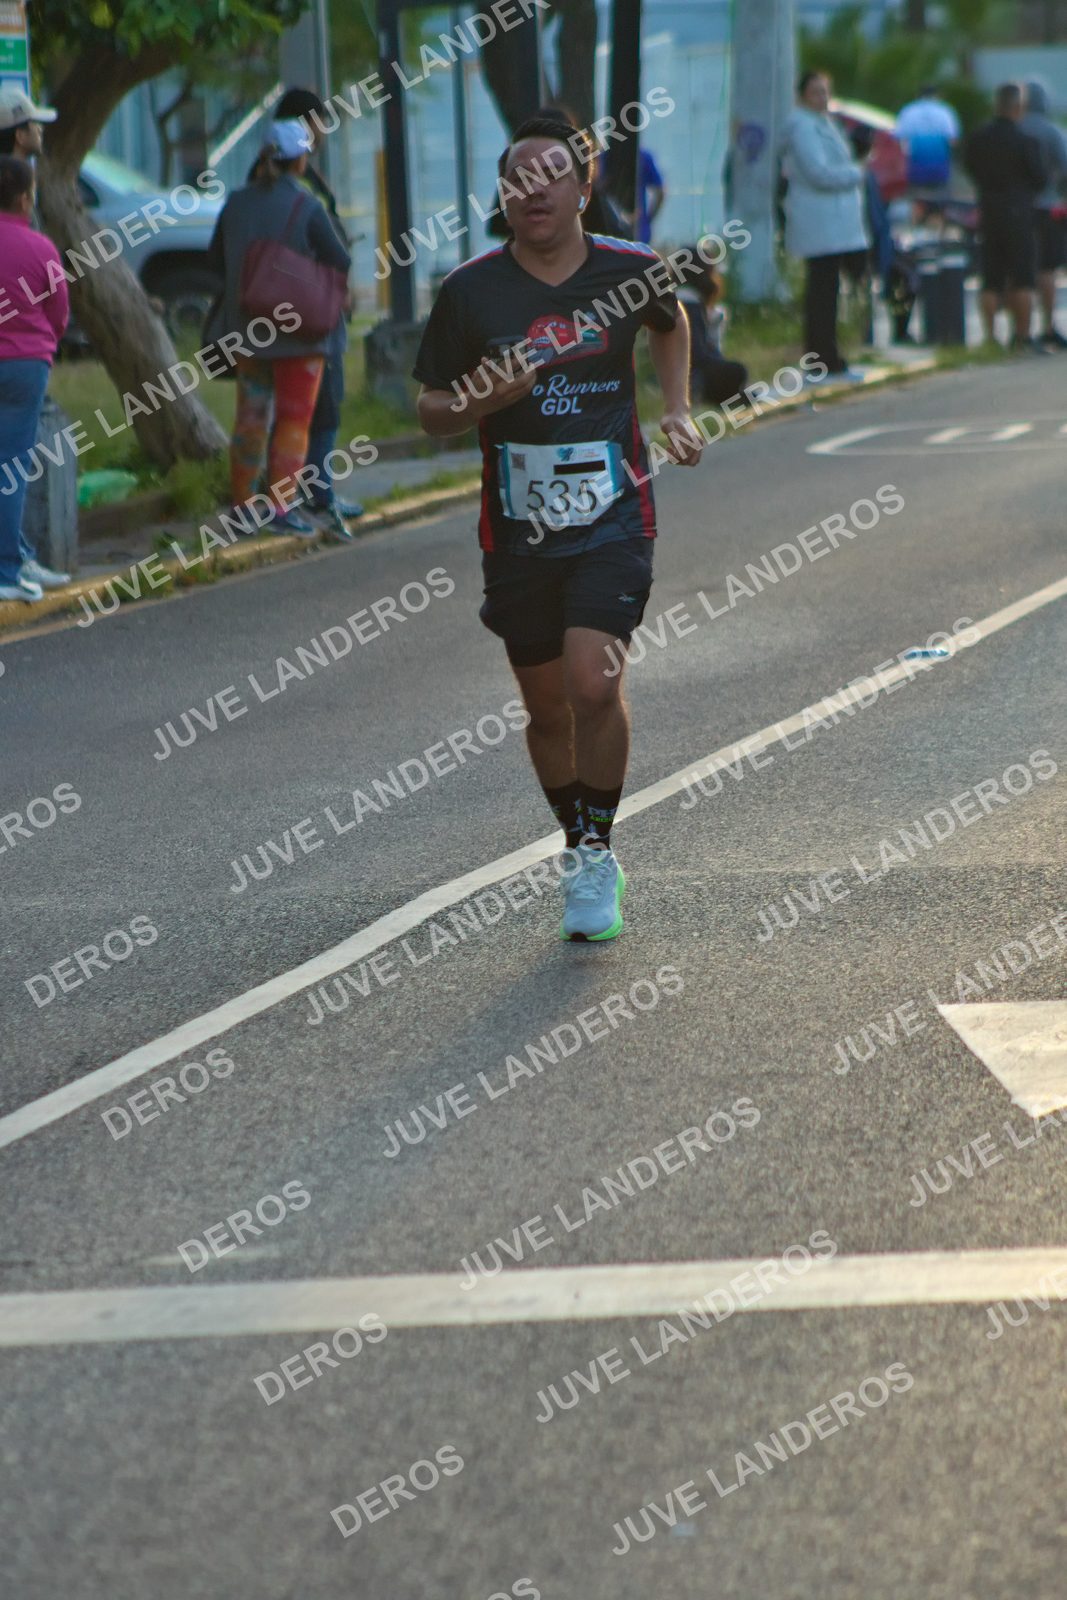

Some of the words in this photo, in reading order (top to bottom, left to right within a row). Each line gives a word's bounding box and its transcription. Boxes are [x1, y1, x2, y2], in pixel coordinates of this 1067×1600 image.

[546, 374, 621, 398] Runners
[540, 396, 583, 416] GDL
[526, 479, 597, 514] 535
